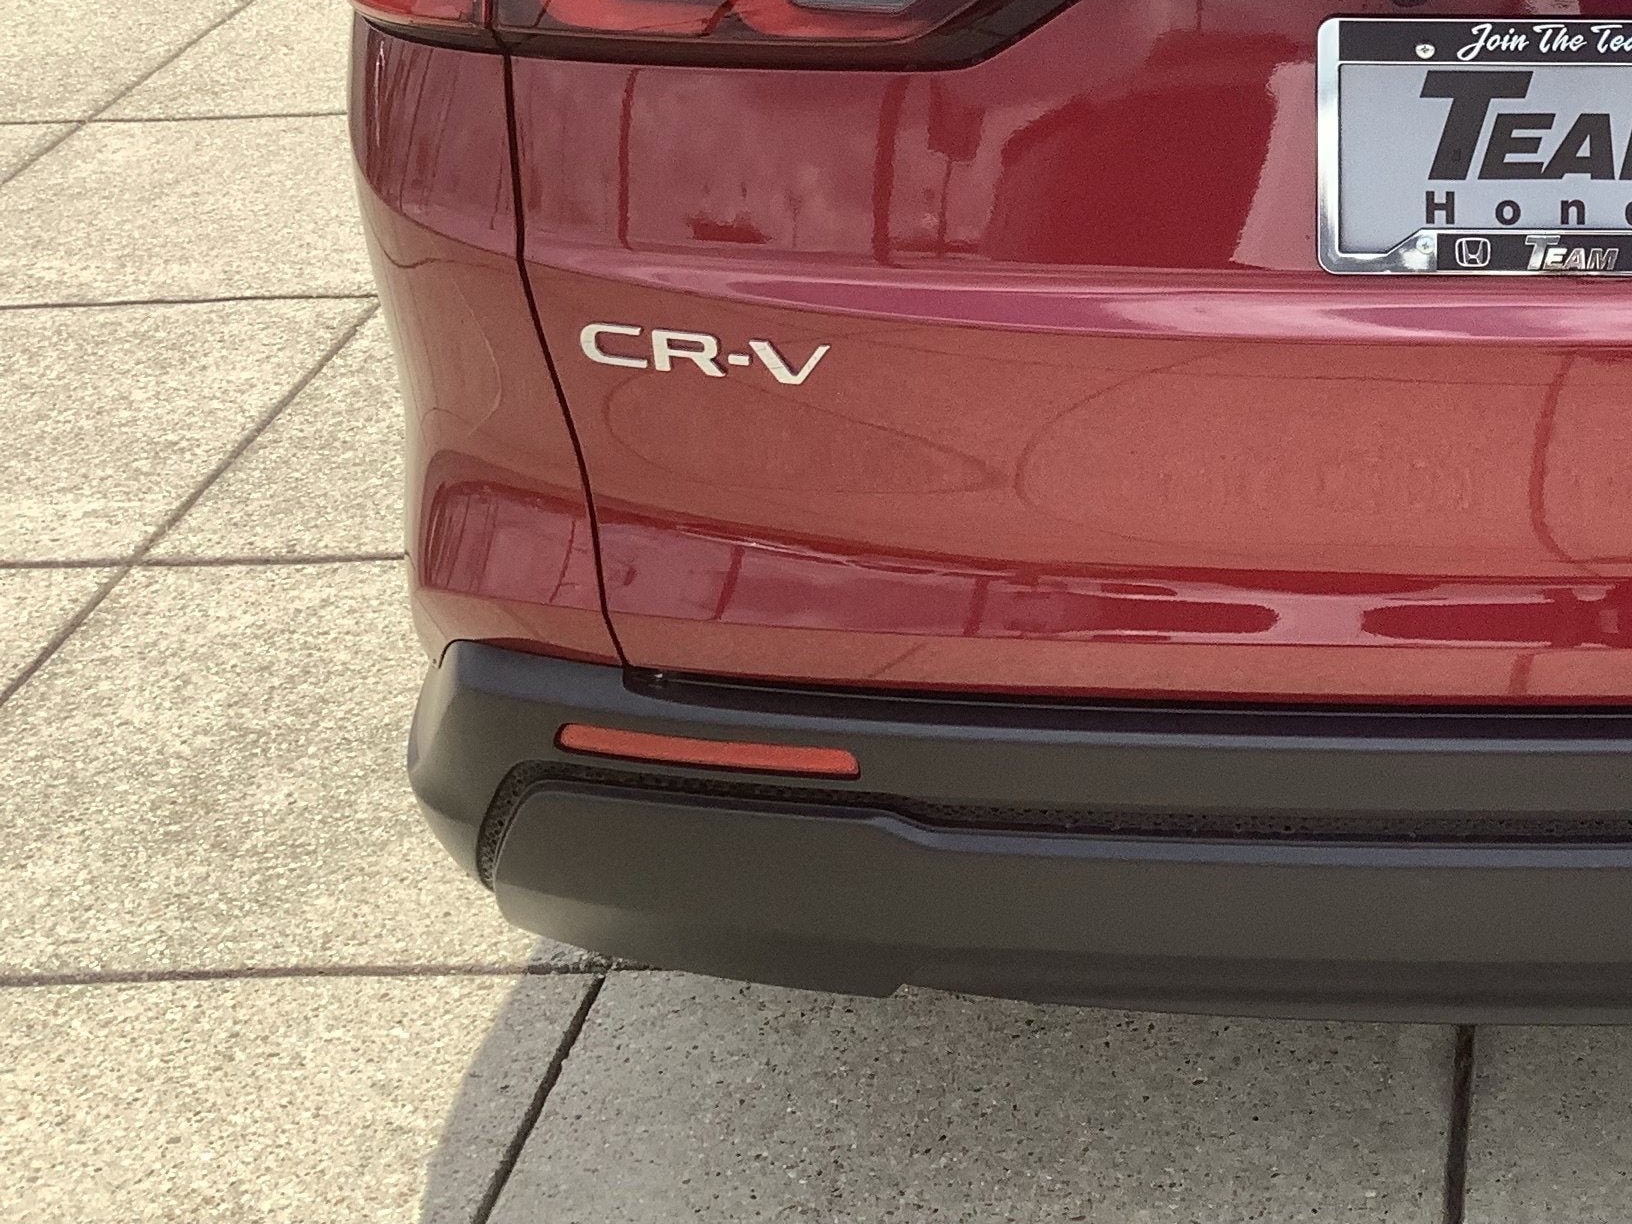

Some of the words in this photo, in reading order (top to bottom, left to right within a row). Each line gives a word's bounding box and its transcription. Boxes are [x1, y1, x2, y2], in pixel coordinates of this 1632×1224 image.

[1456, 23, 1530, 61] Join
[1532, 24, 1588, 54] The
[1524, 234, 1620, 271] TEAM
[579, 322, 831, 386] CR-V
